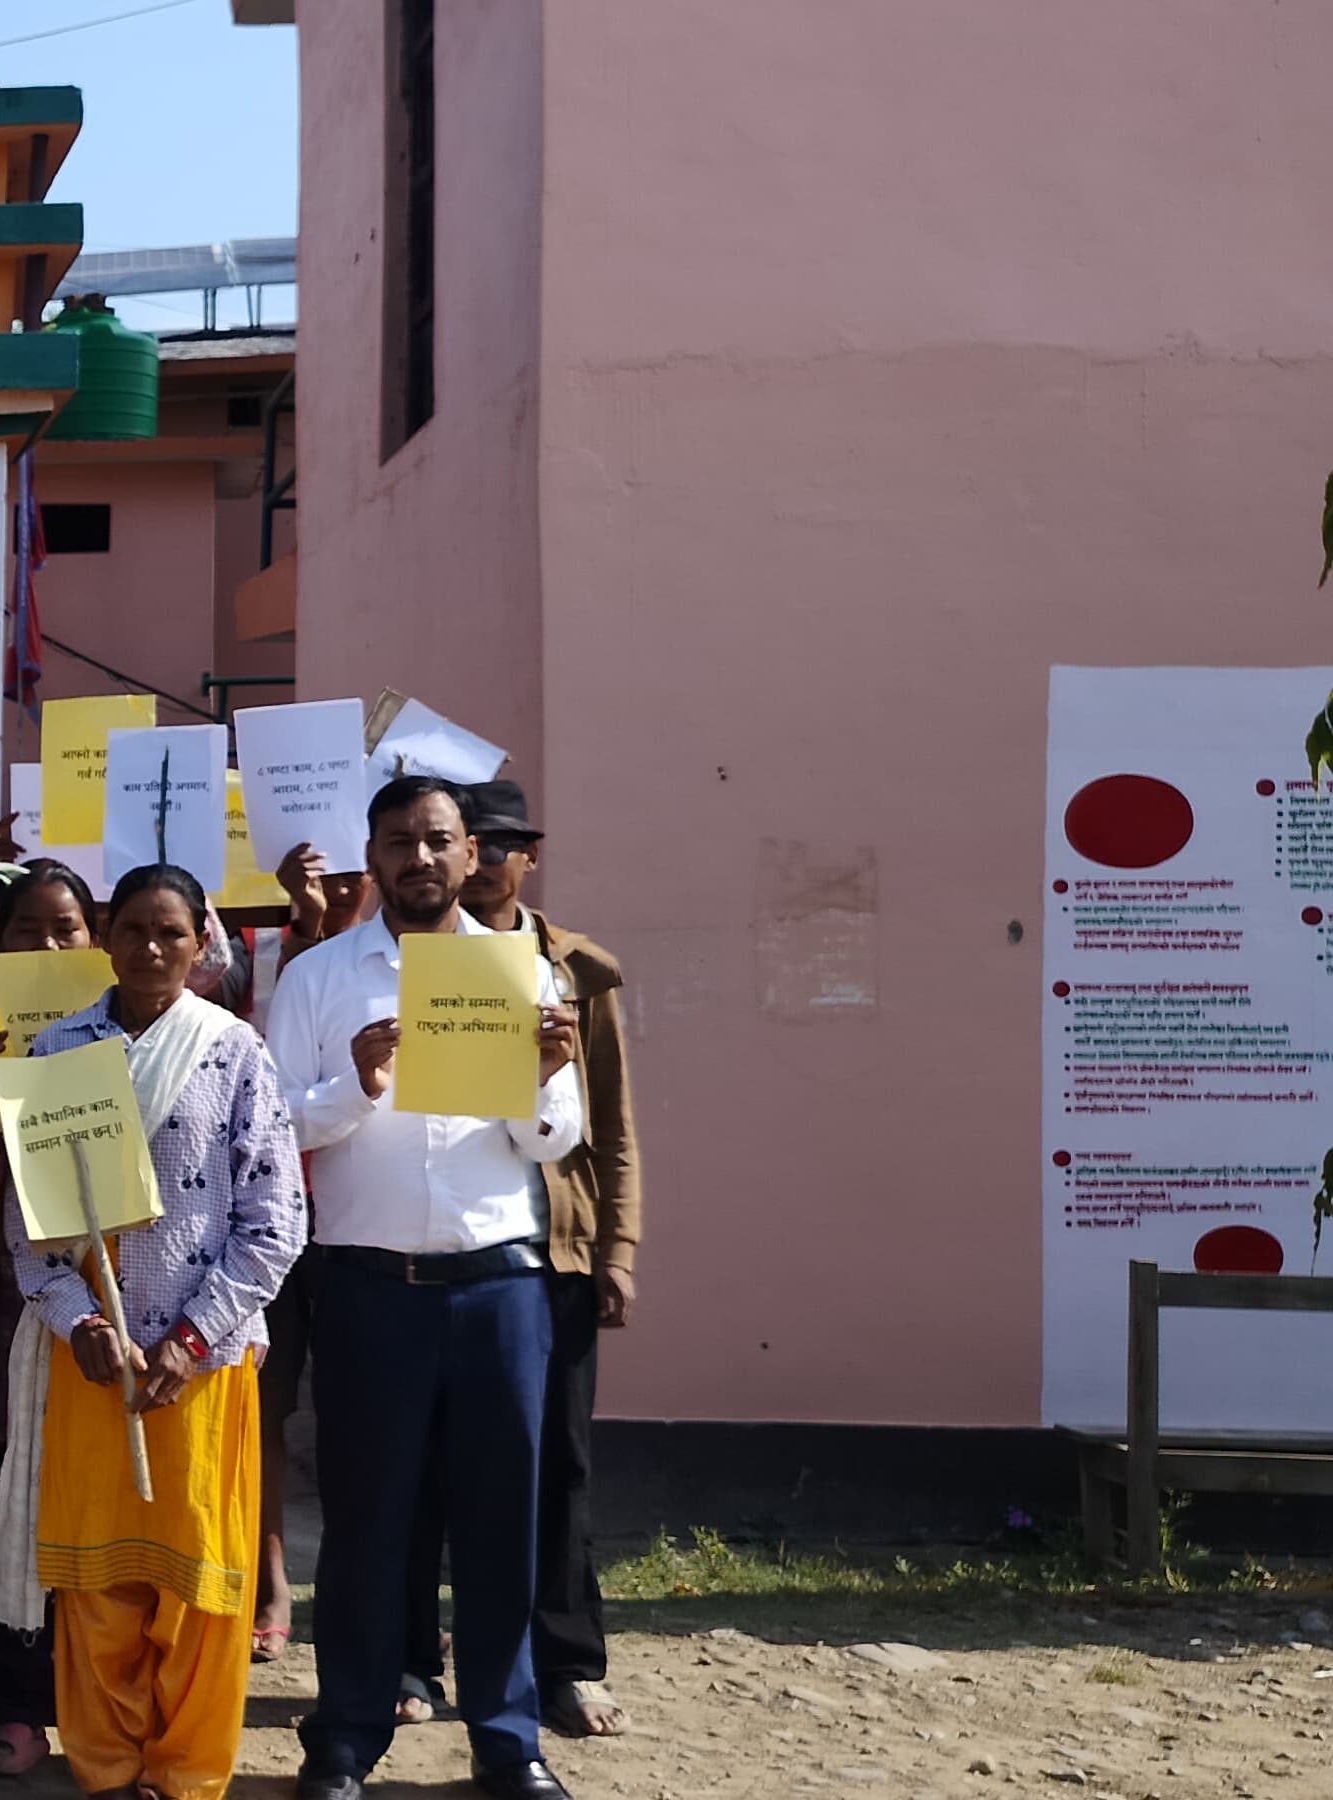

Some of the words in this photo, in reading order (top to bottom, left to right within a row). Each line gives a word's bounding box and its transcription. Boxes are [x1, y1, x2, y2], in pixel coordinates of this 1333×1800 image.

[430, 993, 465, 1008] श्रमको
[467, 998, 510, 1012] सम्मान,
[417, 1017, 455, 1035] राष्ट्रको
[460, 1017, 507, 1033] अभियान
[20, 1114, 38, 1129] सबै
[41, 1104, 87, 1124] वैधानिक
[89, 1098, 119, 1112] काम,
[25, 1135, 61, 1153] सम्मान
